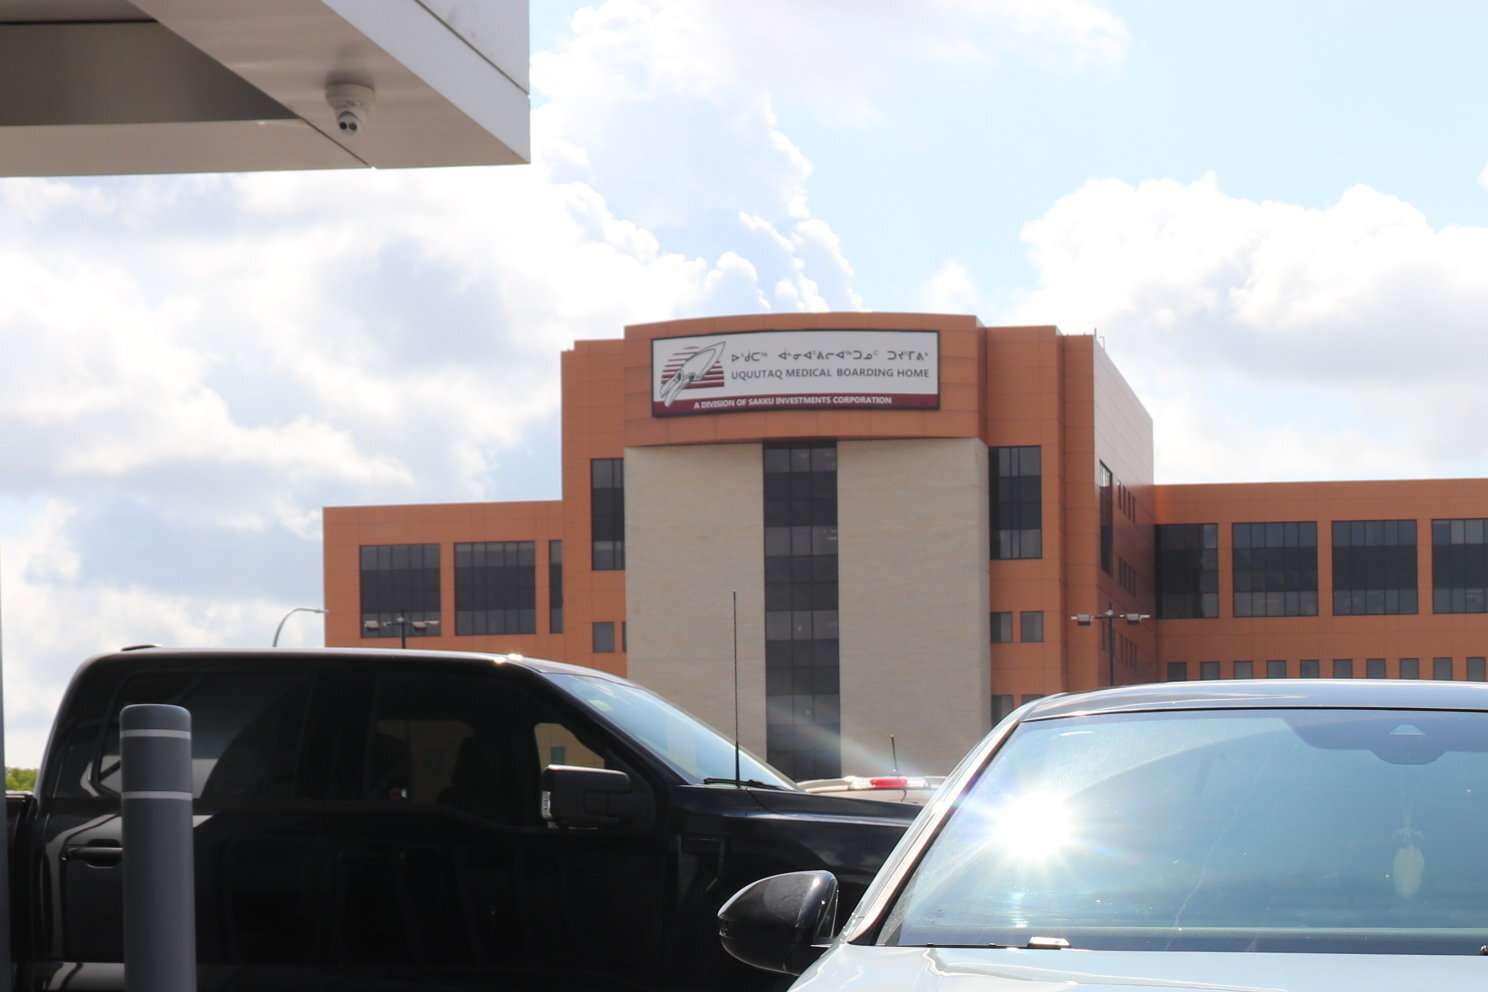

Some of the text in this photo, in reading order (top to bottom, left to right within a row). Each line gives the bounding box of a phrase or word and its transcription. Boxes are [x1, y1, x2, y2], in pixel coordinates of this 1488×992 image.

[731, 368, 929, 380] UQUUTAQ MEDICAL BOARDING HOME
[701, 399, 736, 409] DIVISION
[736, 398, 747, 407] OF
[748, 397, 774, 406] SAKKU
[775, 396, 831, 405] INVESTMENTS
[832, 396, 893, 404] CORPORATION
